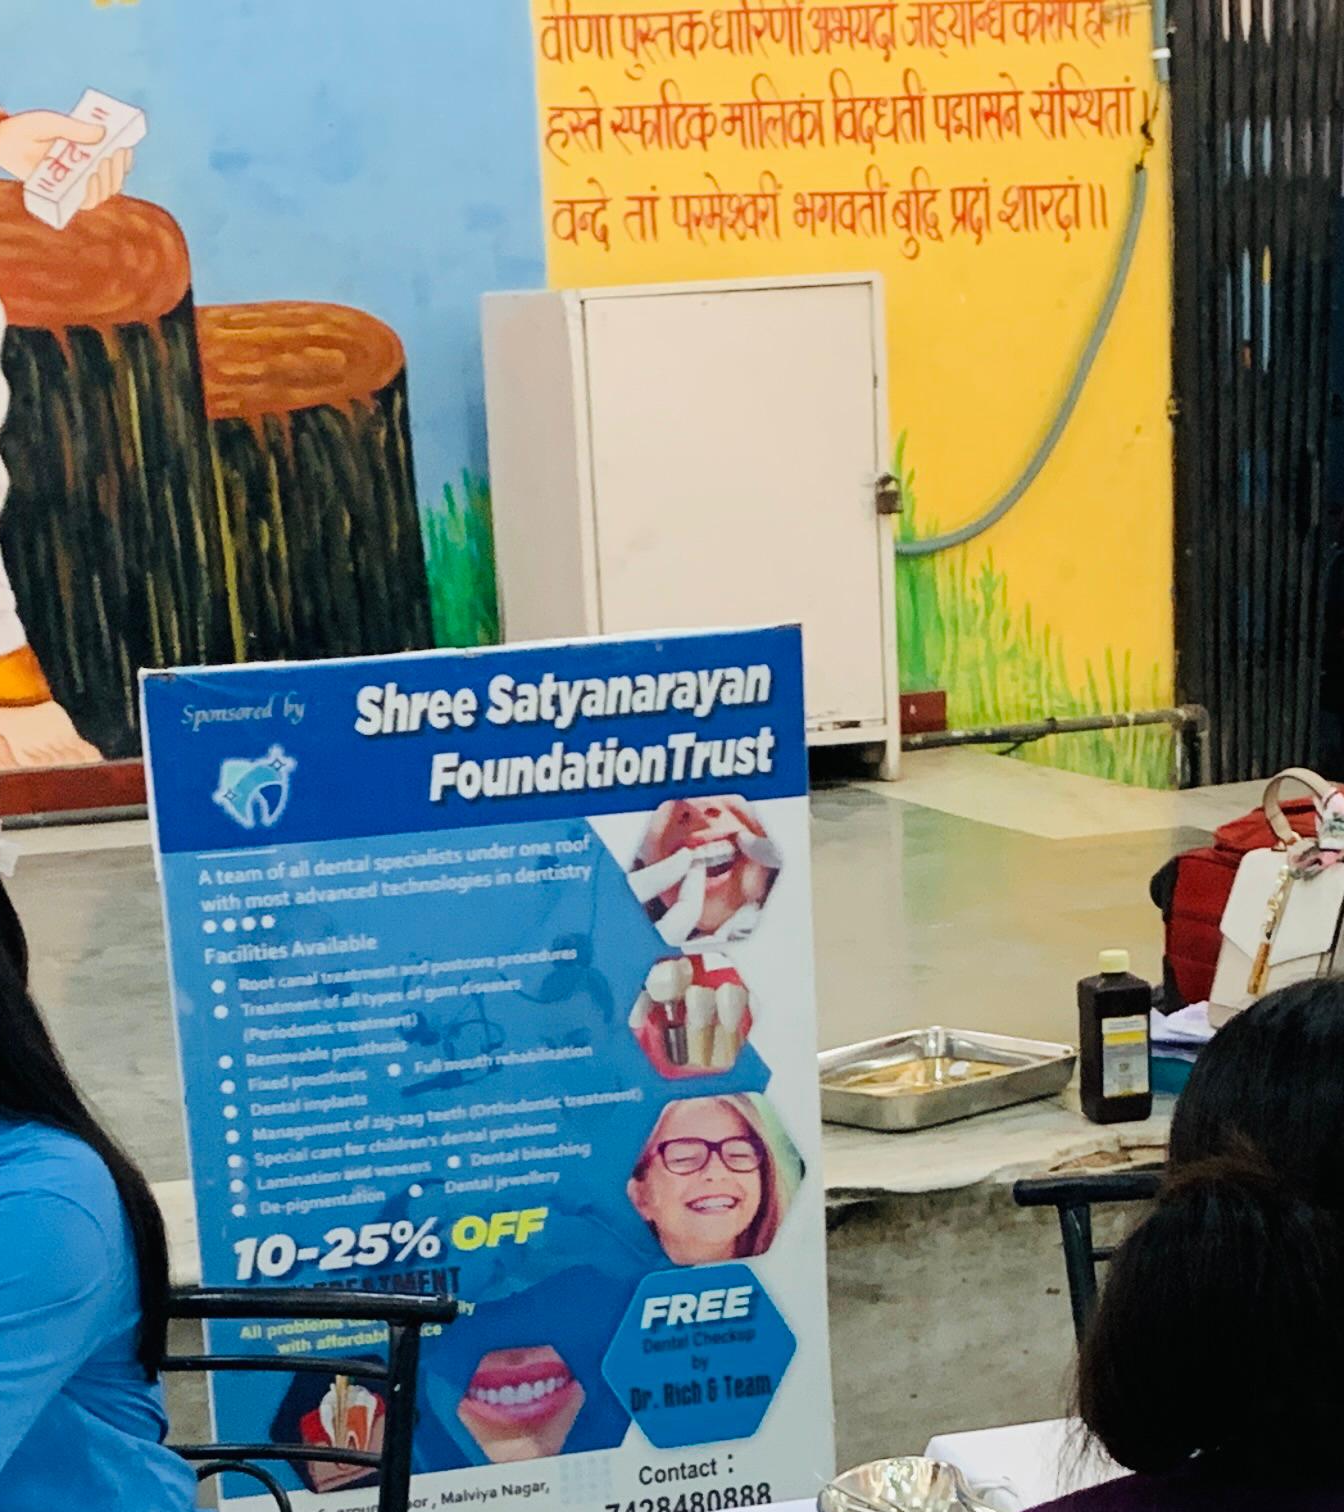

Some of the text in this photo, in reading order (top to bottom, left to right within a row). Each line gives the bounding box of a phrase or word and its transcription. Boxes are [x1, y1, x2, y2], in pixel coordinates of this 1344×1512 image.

[181, 690, 306, 733] Sponsored by
[352, 657, 771, 736] Shree Satyanarayan
[198, 833, 590, 885] A team of all dental specialists under one roof
[200, 862, 592, 911] with most advanced technologies in dentistry
[203, 934, 378, 964] Facilities Available
[238, 976, 274, 991] Root
[277, 972, 317, 988] canal
[320, 966, 397, 983] treatment
[399, 960, 428, 975] and
[497, 948, 577, 968] procedures
[240, 977, 521, 1016] Treatment of all types of gum diseases
[414, 1058, 441, 1074] Full
[443, 1054, 492, 1070] mouth
[250, 1092, 367, 1116] Dental implants
[252, 1120, 351, 1144] Management
[353, 1115, 369, 1131] of
[371, 1111, 424, 1131] zig-zag
[427, 1106, 467, 1122] teeth
[564, 1088, 643, 1108] treatment)
[254, 1148, 309, 1168] Special
[311, 1147, 342, 1159] care
[344, 1140, 365, 1155] for
[440, 1128, 487, 1145] dental
[489, 1121, 557, 1141] problems
[470, 1142, 592, 1165] Dental bleaching
[444, 1176, 493, 1193] Dental
[260, 1190, 385, 1216] De-pigmentation
[233, 1208, 549, 1278] 10-25% OFF
[639, 1286, 752, 1327] FREE
[239, 1325, 262, 1339] All
[266, 1316, 342, 1338] problems
[277, 1338, 311, 1354] with
[315, 1330, 388, 1349] affordabl
[643, 1326, 755, 1353] Dental Checkup
[691, 1353, 708, 1371] by
[663, 1379, 700, 1407] Rich
[724, 1370, 771, 1399] Team
[638, 1458, 716, 1483] Contact
[441, 1486, 496, 1506] Malviya
[502, 1481, 550, 1499] Nagar,
